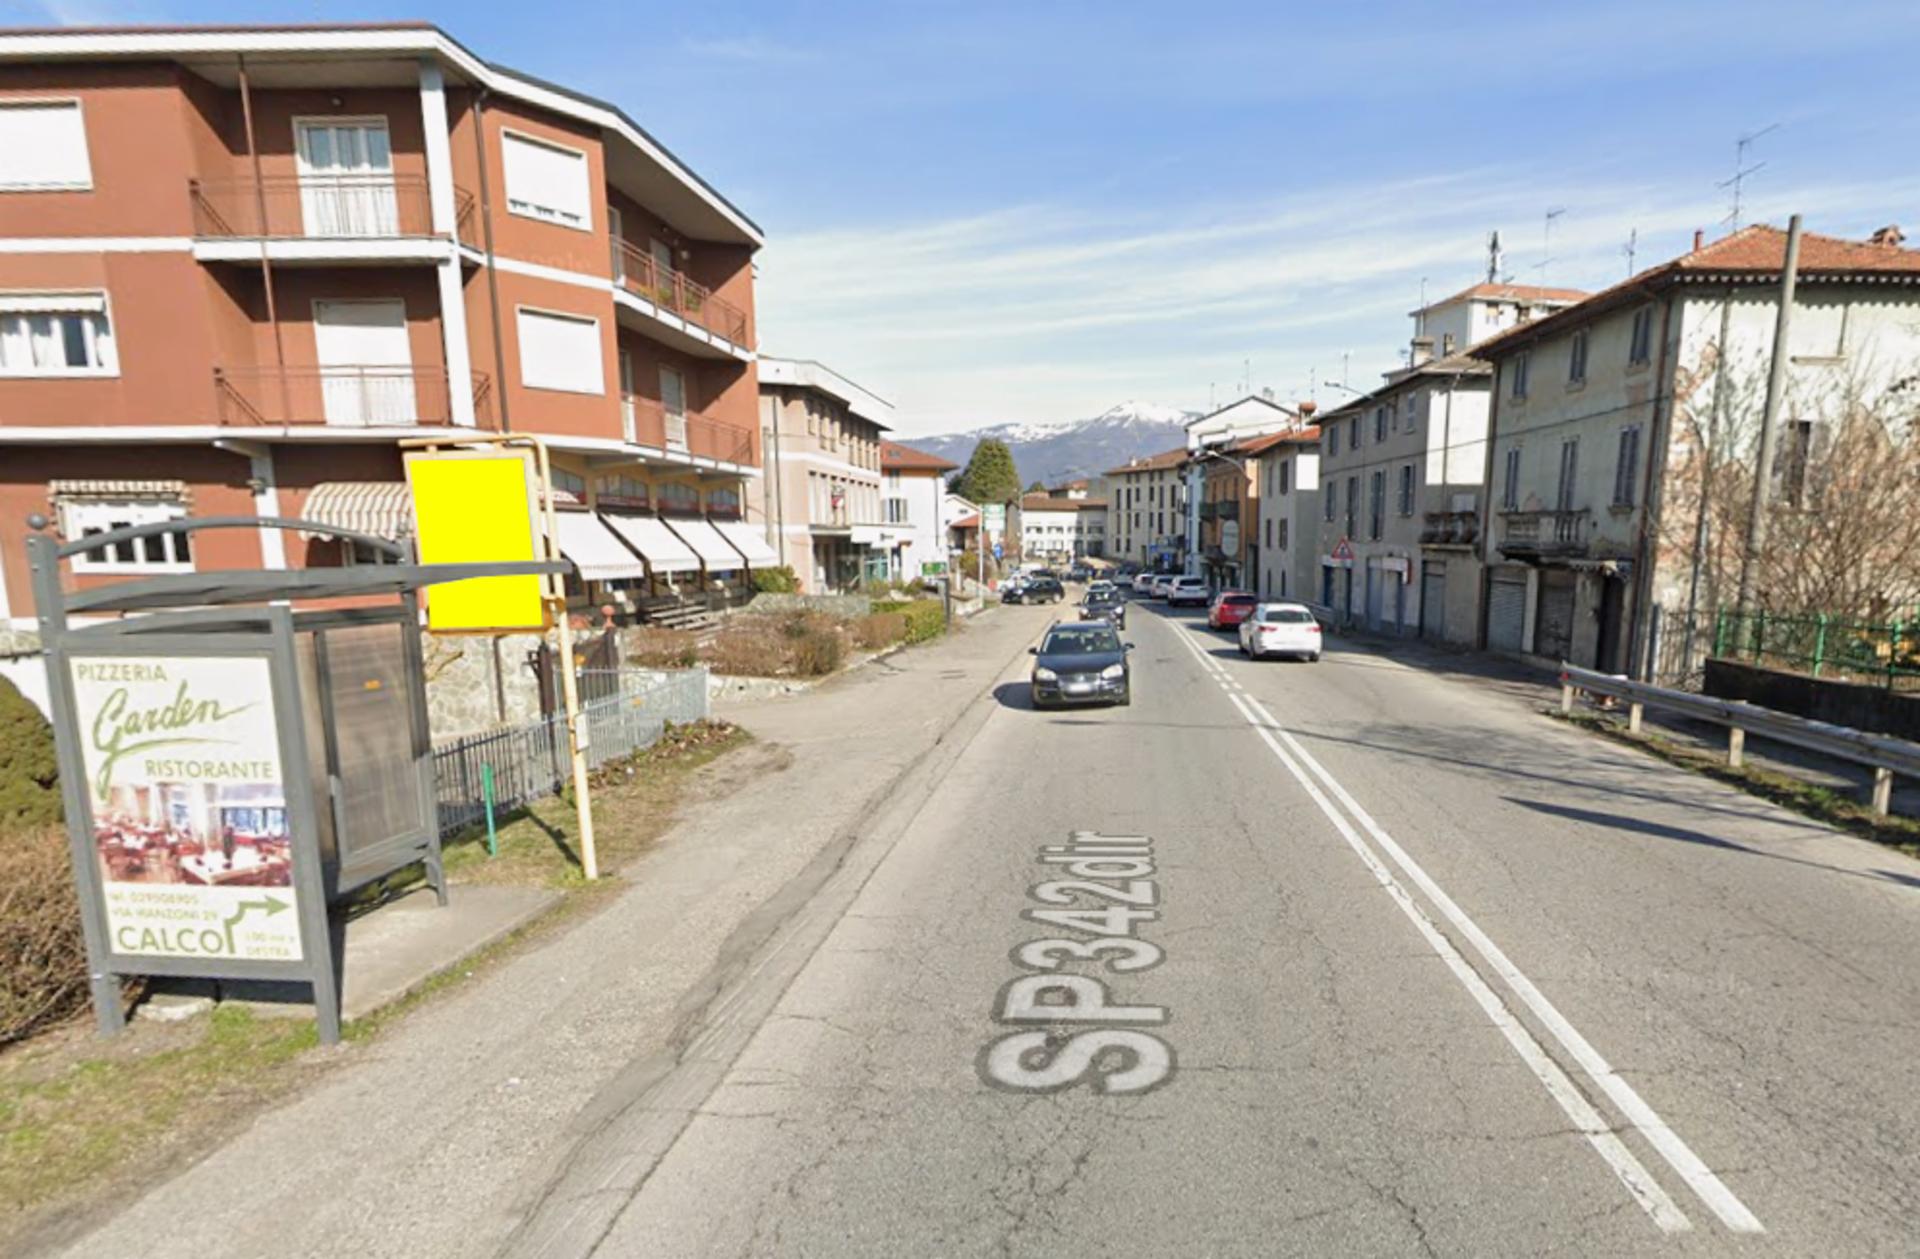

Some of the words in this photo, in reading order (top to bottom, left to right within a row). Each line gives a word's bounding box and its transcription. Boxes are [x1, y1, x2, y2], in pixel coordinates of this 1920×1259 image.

[76, 663, 168, 682] PIZZERIA
[92, 679, 262, 802] Garden
[144, 759, 274, 779] RISTORANTE
[117, 926, 225, 954] CALCO
